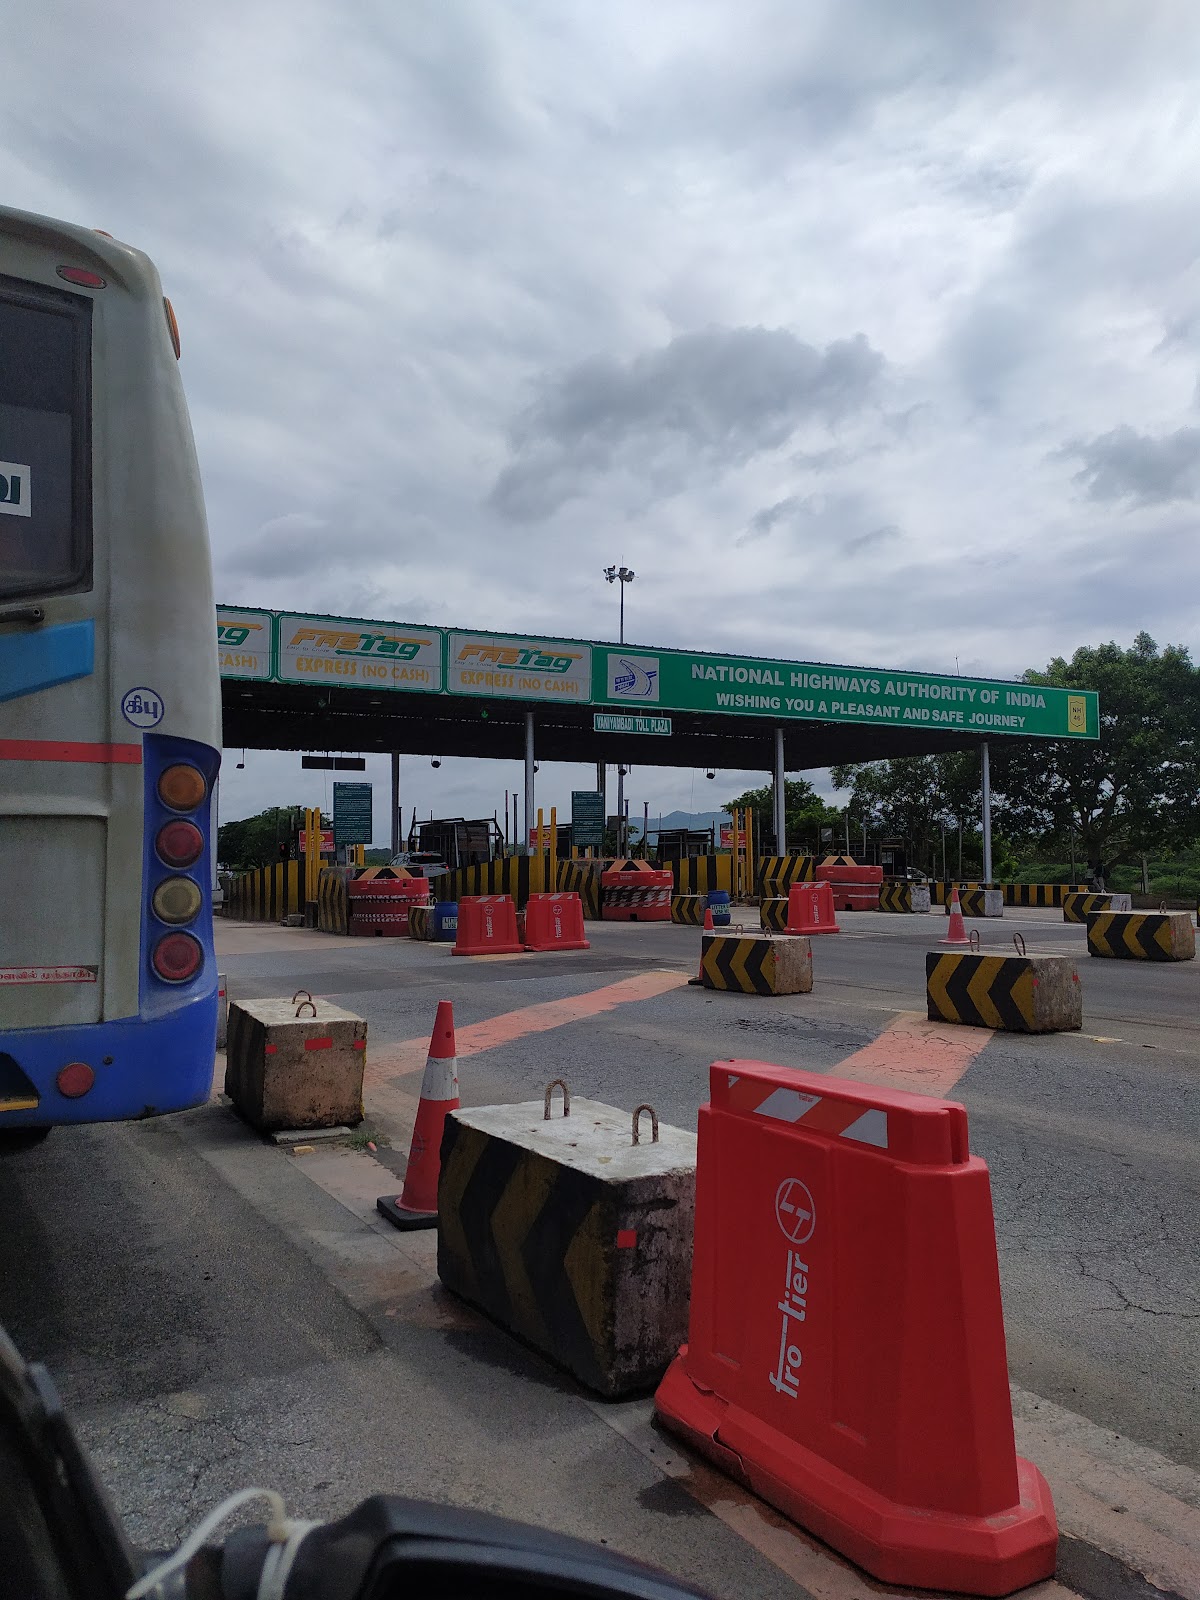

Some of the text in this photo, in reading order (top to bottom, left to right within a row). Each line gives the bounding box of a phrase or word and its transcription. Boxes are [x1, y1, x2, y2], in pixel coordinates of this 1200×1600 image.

[296, 657, 430, 683] EXPRESS (NO CASH)
[461, 671, 579, 694] EXPRESS (NO CASH)
[691, 663, 1046, 709] NATIONAL HIGHWAYS AUTHORITY OF INDIA
[716, 692, 1026, 728] WISHING YOU A PLEASANT AND SAFE JOURNEY
[636, 719, 649, 732] TOLL
[651, 720, 669, 733] PLAZA
[768, 1249, 809, 1399] frotier
